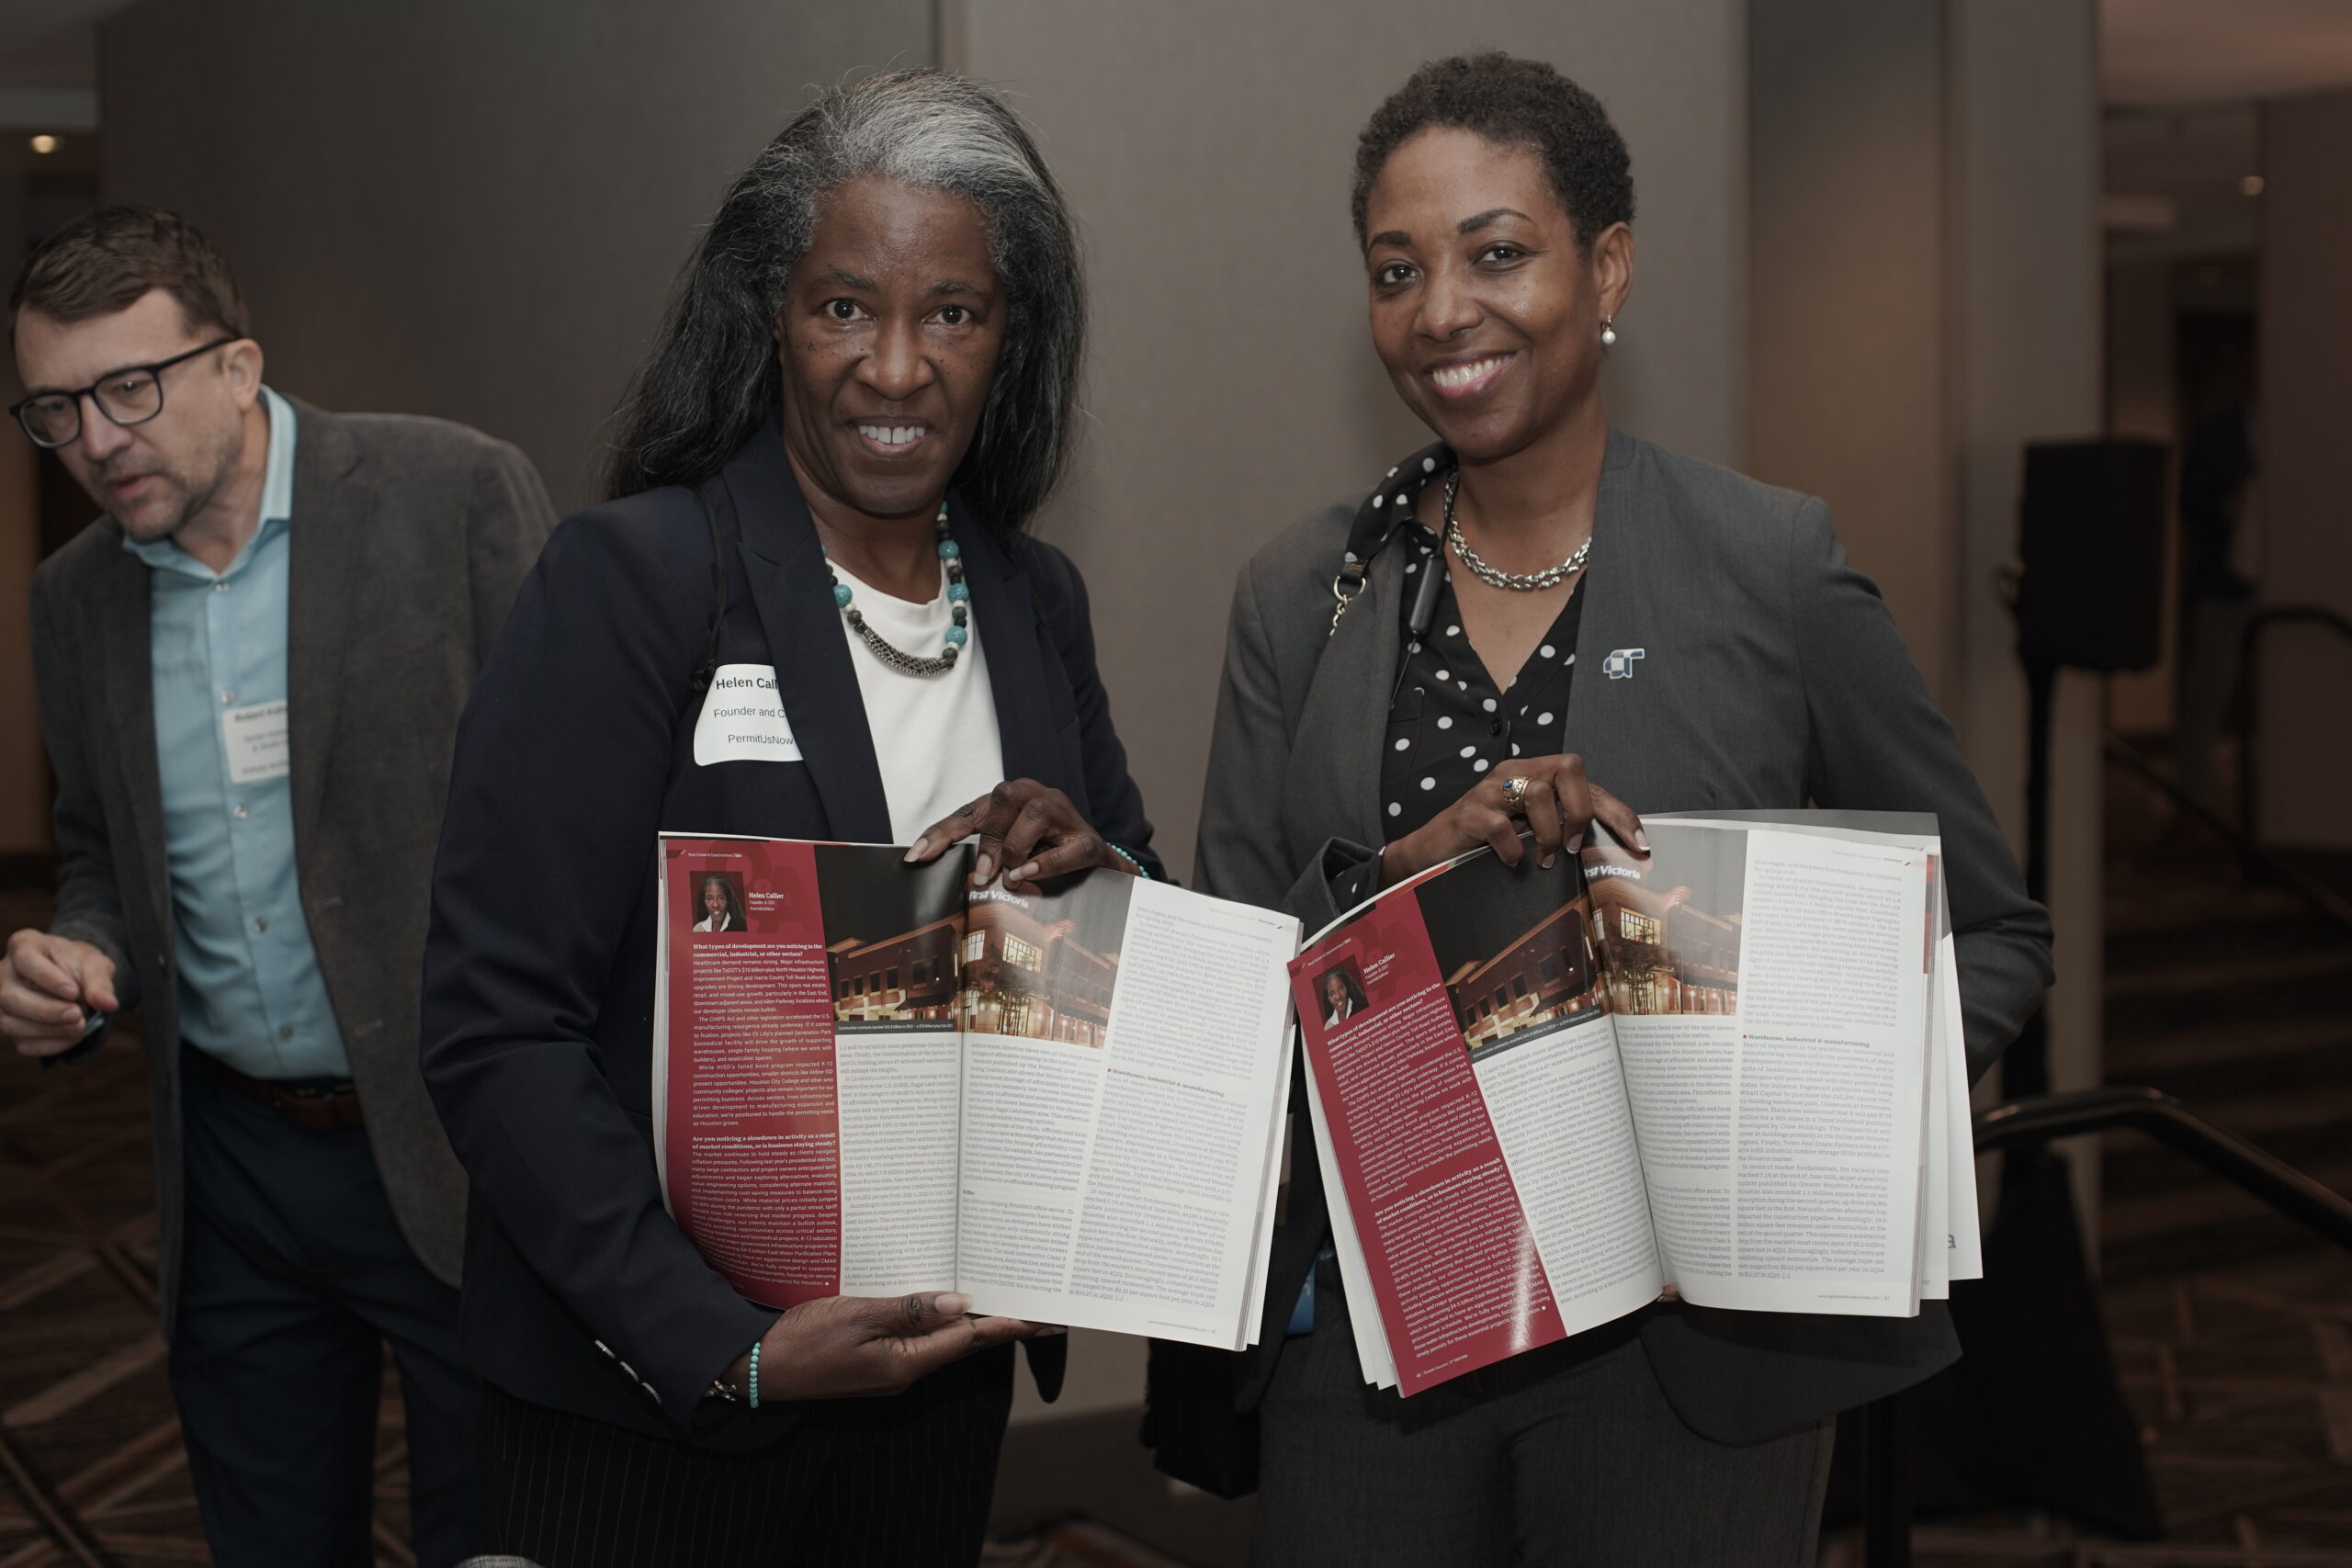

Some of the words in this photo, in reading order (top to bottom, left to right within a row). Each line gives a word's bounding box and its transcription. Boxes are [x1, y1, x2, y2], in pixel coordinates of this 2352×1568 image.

[716, 677, 752, 690] Helen
[713, 706, 757, 718] Founder
[759, 708, 775, 717] and
[728, 734, 795, 745] PermitUsNow
[1600, 865, 1641, 880] Victoria
[969, 890, 989, 901] First
[990, 890, 1029, 909] Victoria
[1363, 963, 1379, 974] Helen
[1378, 953, 1395, 965] Callier
[1327, 1036, 1340, 1045] What
[1340, 1030, 1353, 1039] types
[1358, 1010, 1388, 1029] development
[1396, 1000, 1406, 1009] you
[1406, 989, 1427, 1003] noticing
[1329, 1034, 1358, 1053] commercial,
[1358, 1021, 1383, 1037] industrial,
[1389, 1010, 1402, 1021] other
[1403, 998, 1423, 1012] sectors?
[1824, 1040, 1870, 1048] manufacturing
[1113, 1068, 1146, 1080] Warehouse,
[1148, 1076, 1176, 1086] industrial
[1182, 1084, 1225, 1098] manufacturing
[1382, 1210, 1400, 1222] market
[1400, 1199, 1428, 1213] conditions,
[1438, 1182, 1462, 1195] business
[1462, 1174, 1482, 1185] staying
[1482, 1165, 1503, 1177] steady?
[1384, 1205, 1394, 1213] you
[1394, 1195, 1415, 1208] noticing
[1419, 1181, 1445, 1196] slowdown
[1451, 1170, 1472, 1181] activity
[1484, 1157, 1500, 1168] result
